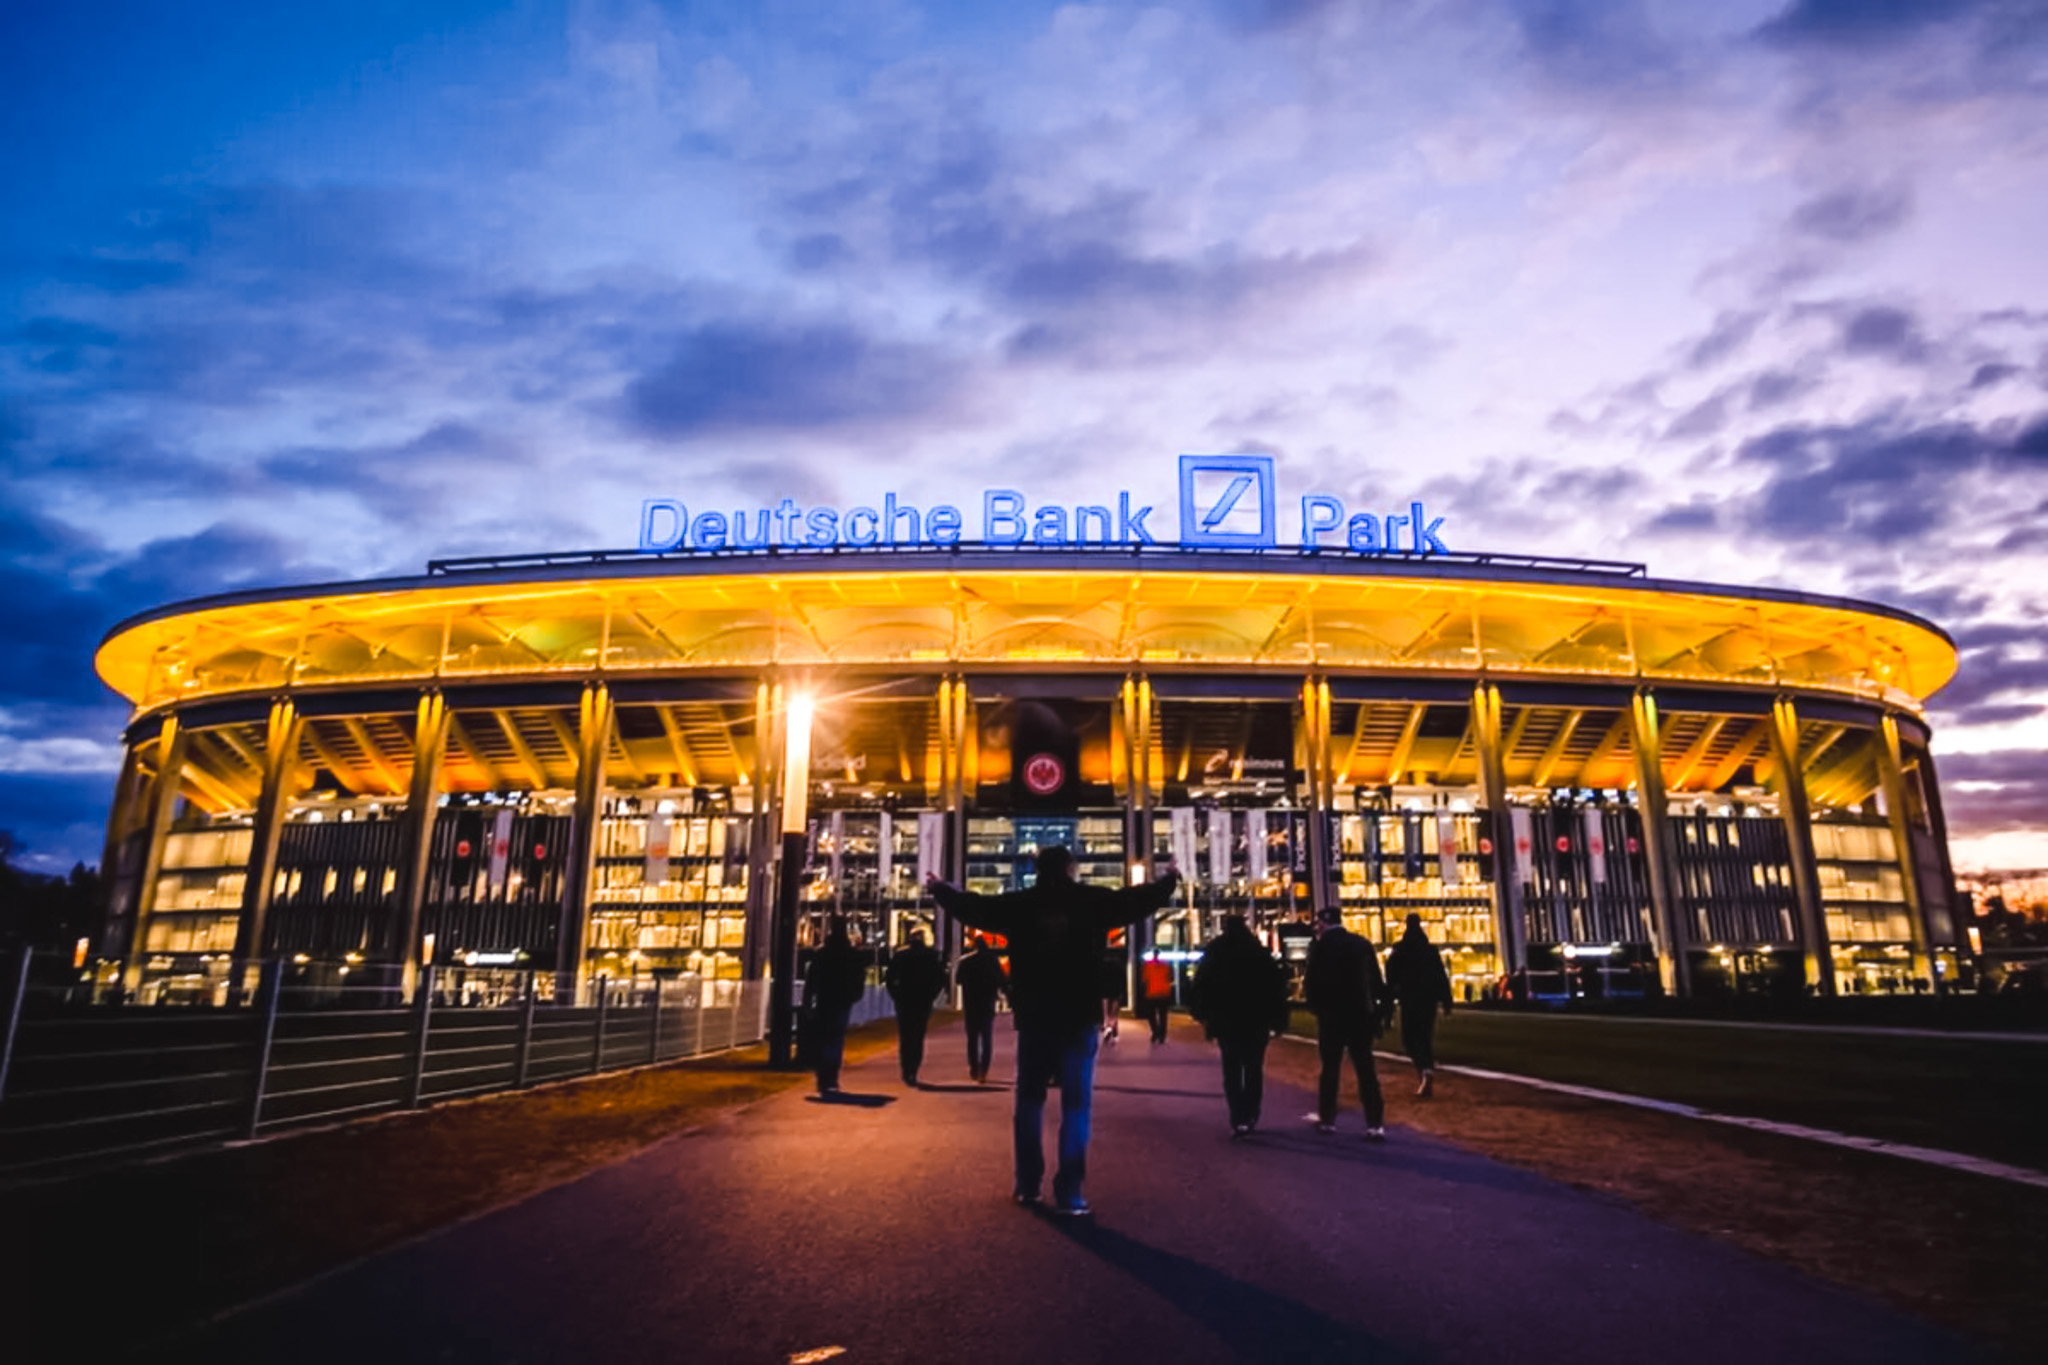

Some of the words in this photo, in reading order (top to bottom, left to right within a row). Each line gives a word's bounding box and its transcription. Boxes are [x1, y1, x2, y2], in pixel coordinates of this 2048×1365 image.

[640, 492, 962, 552] Deutsche
[983, 490, 1154, 546] Bank
[1301, 495, 1450, 555] Park
